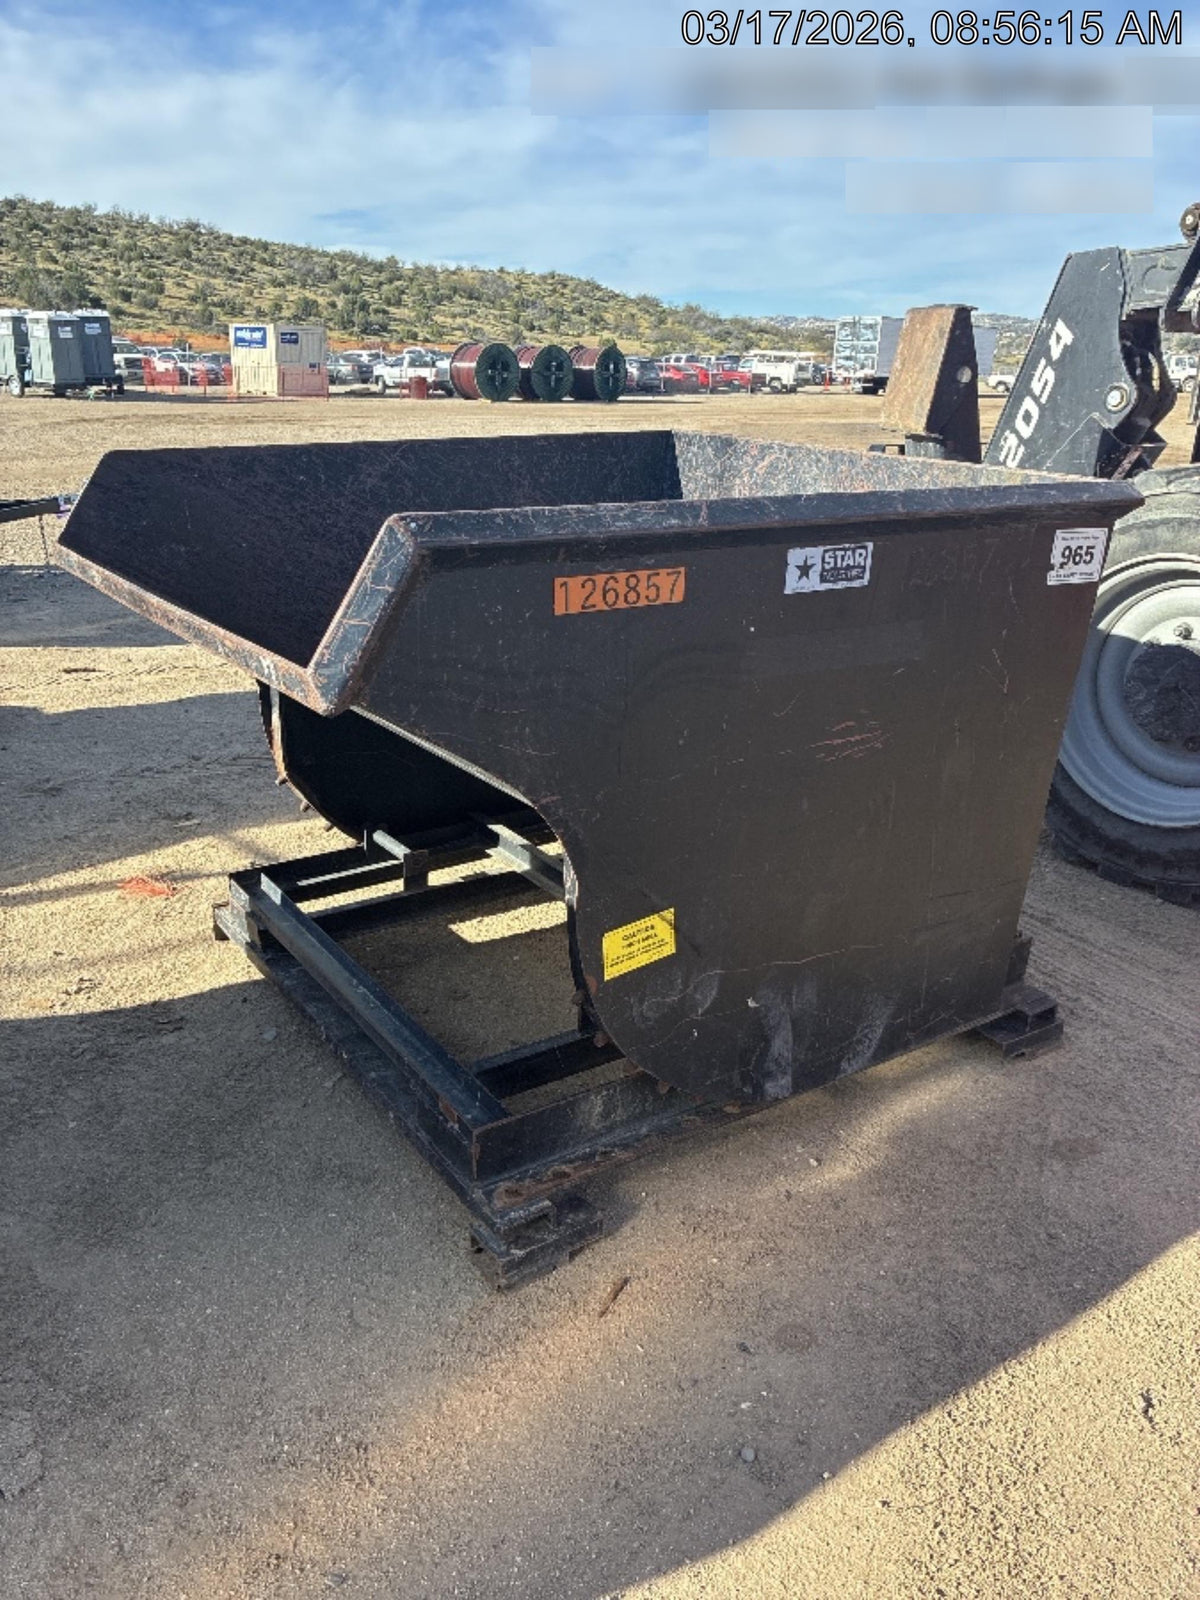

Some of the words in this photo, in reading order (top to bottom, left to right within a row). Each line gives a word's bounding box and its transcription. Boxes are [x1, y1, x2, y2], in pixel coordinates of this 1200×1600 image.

[823, 547, 867, 570] STAR
[1058, 545, 1096, 570] 965
[559, 570, 682, 612] 126857
